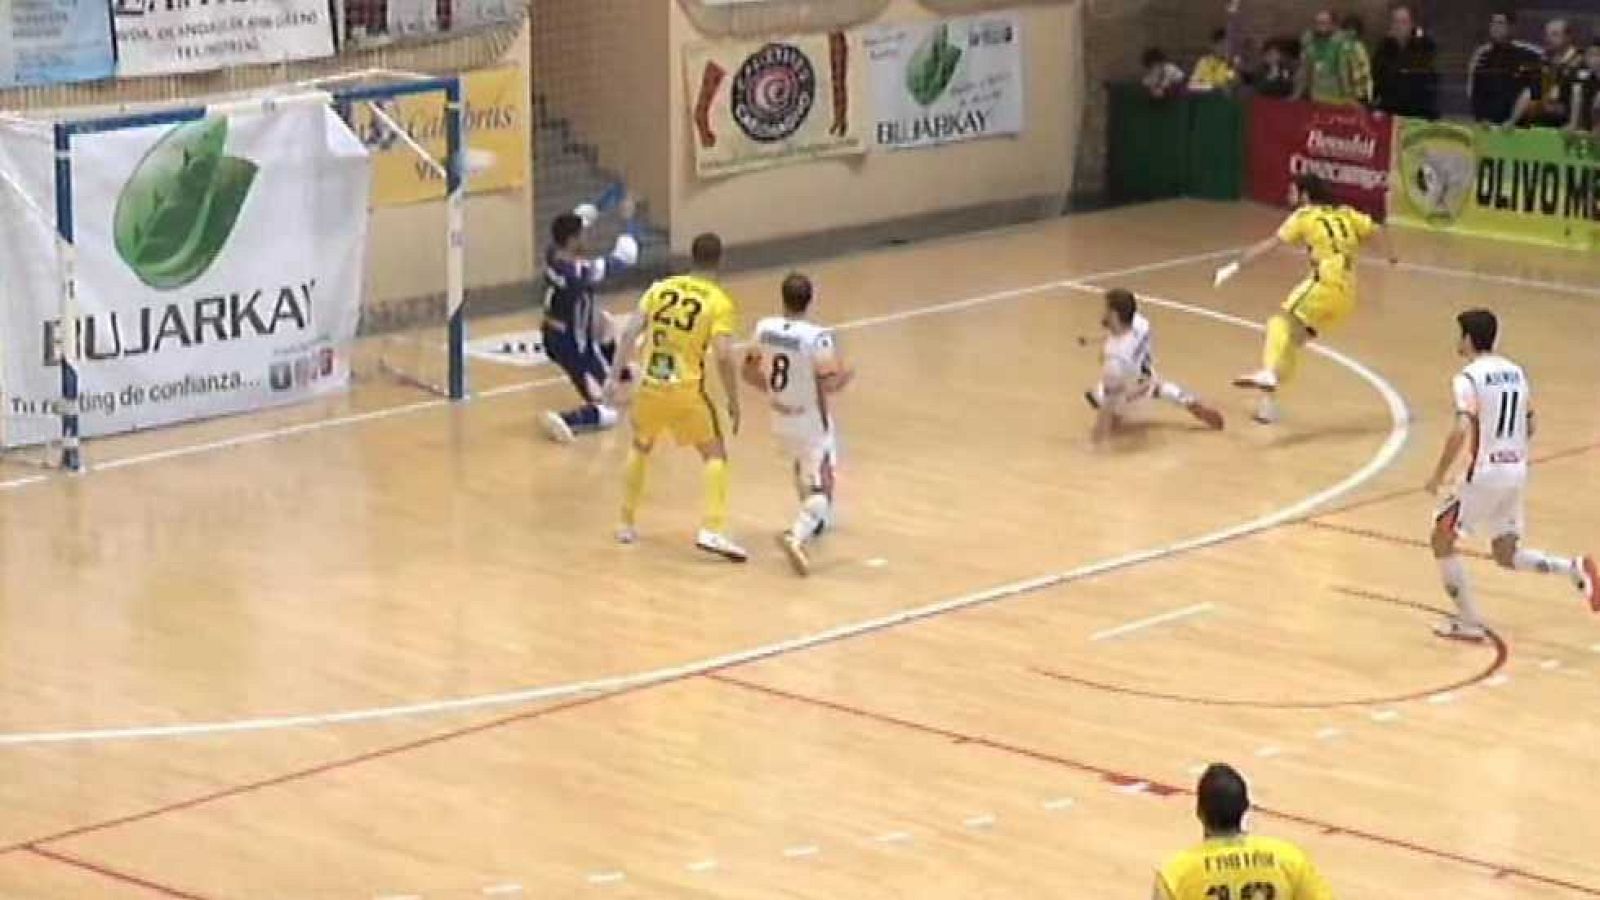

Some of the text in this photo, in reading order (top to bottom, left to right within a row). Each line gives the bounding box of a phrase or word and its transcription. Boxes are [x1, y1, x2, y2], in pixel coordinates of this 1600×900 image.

[1477, 156, 1559, 215] OLIVO
[652, 288, 703, 332] 23
[770, 352, 790, 393] 8
[120, 385, 146, 406] de
[1495, 391, 1520, 439] 11
